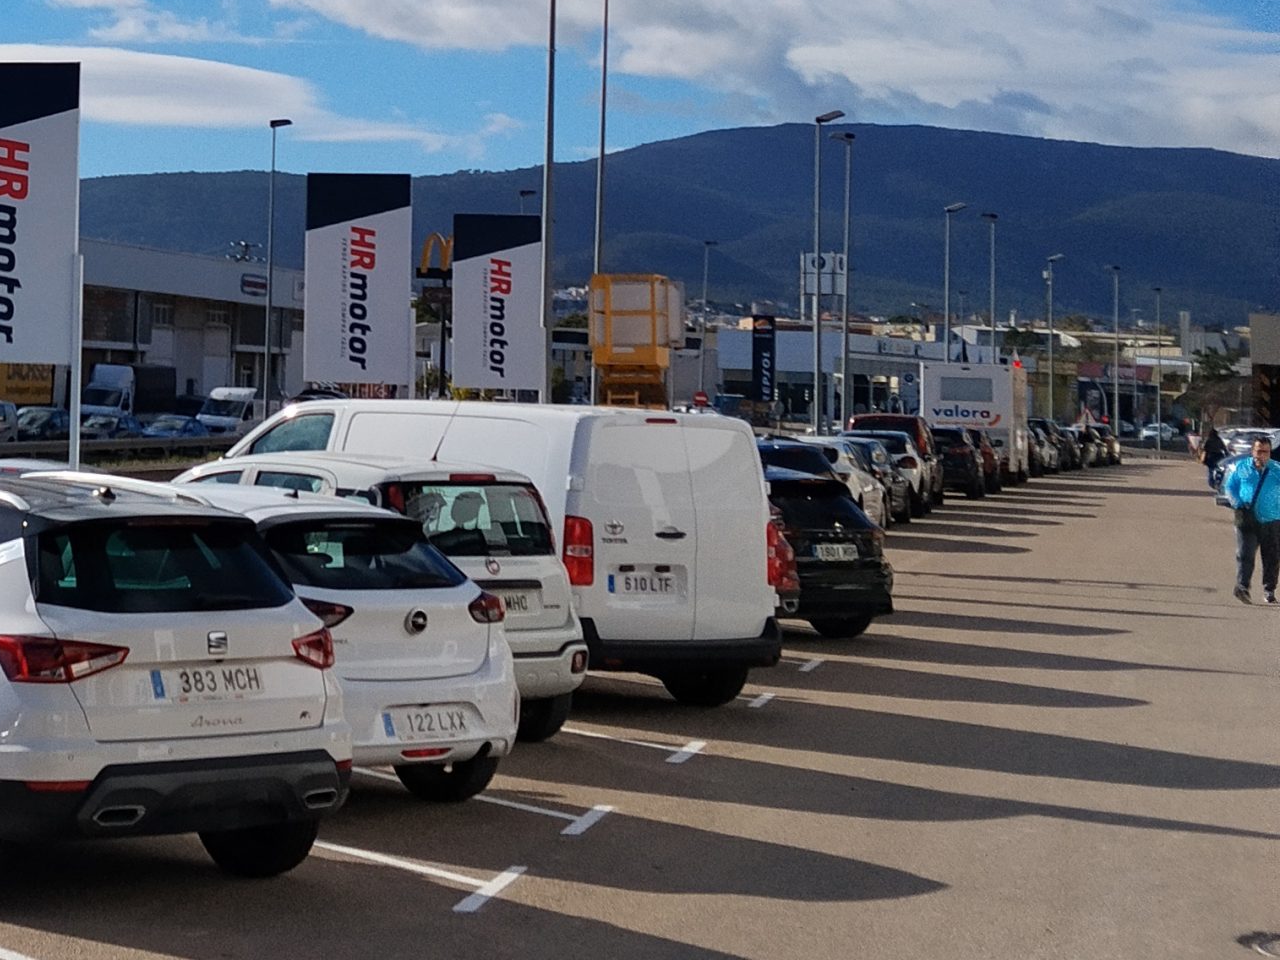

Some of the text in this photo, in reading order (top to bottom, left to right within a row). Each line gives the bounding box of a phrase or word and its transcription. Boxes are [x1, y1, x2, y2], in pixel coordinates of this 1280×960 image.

[348, 225, 376, 371] HRmotor
[932, 404, 991, 419] valora
[179, 668, 261, 694] 383 MCH
[407, 711, 467, 732] 122 LXX
